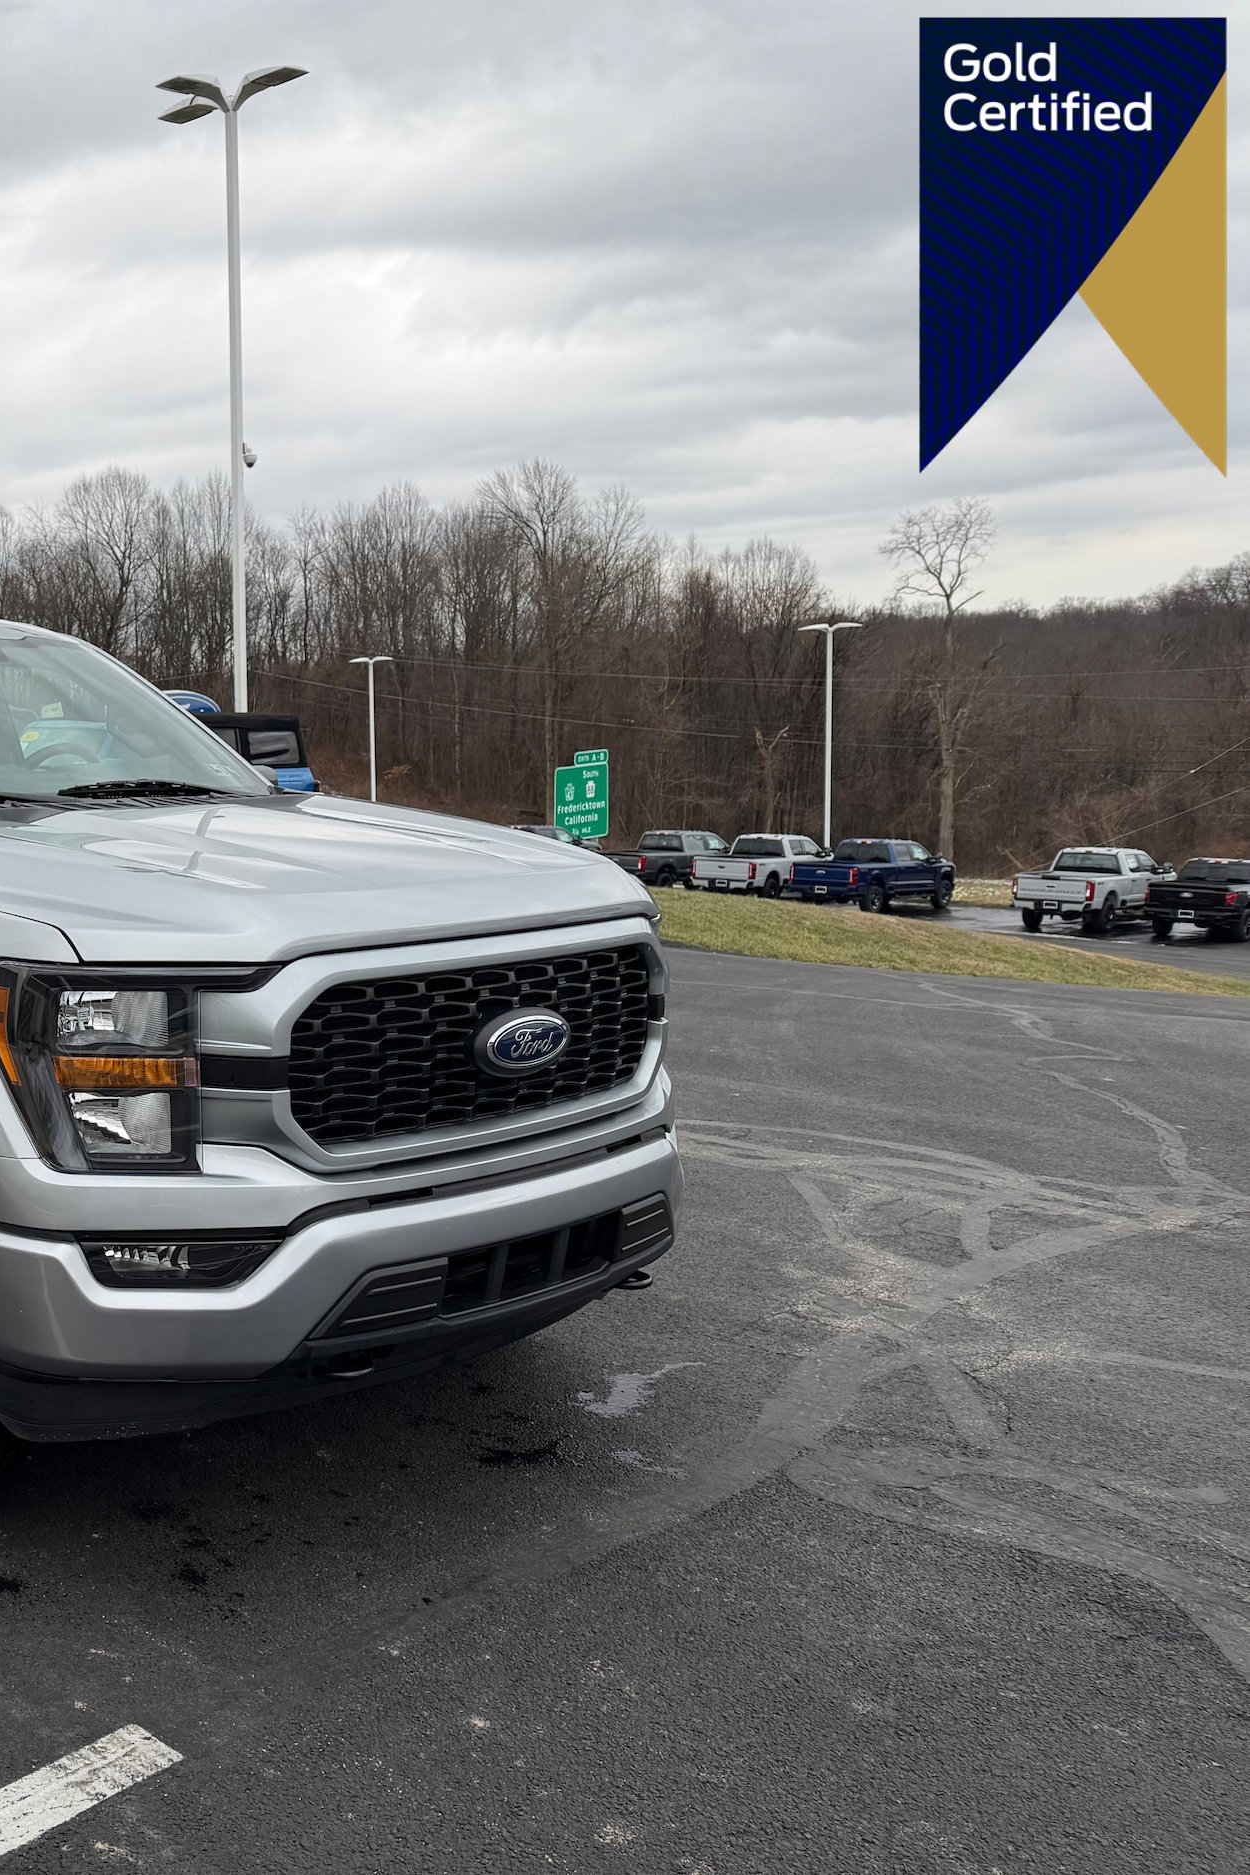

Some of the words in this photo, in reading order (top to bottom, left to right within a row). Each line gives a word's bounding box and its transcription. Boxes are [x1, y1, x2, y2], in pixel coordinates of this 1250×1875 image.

[558, 801, 605, 814] Fredericktown
[565, 813, 598, 826] California
[510, 1026, 554, 1059] Ford
